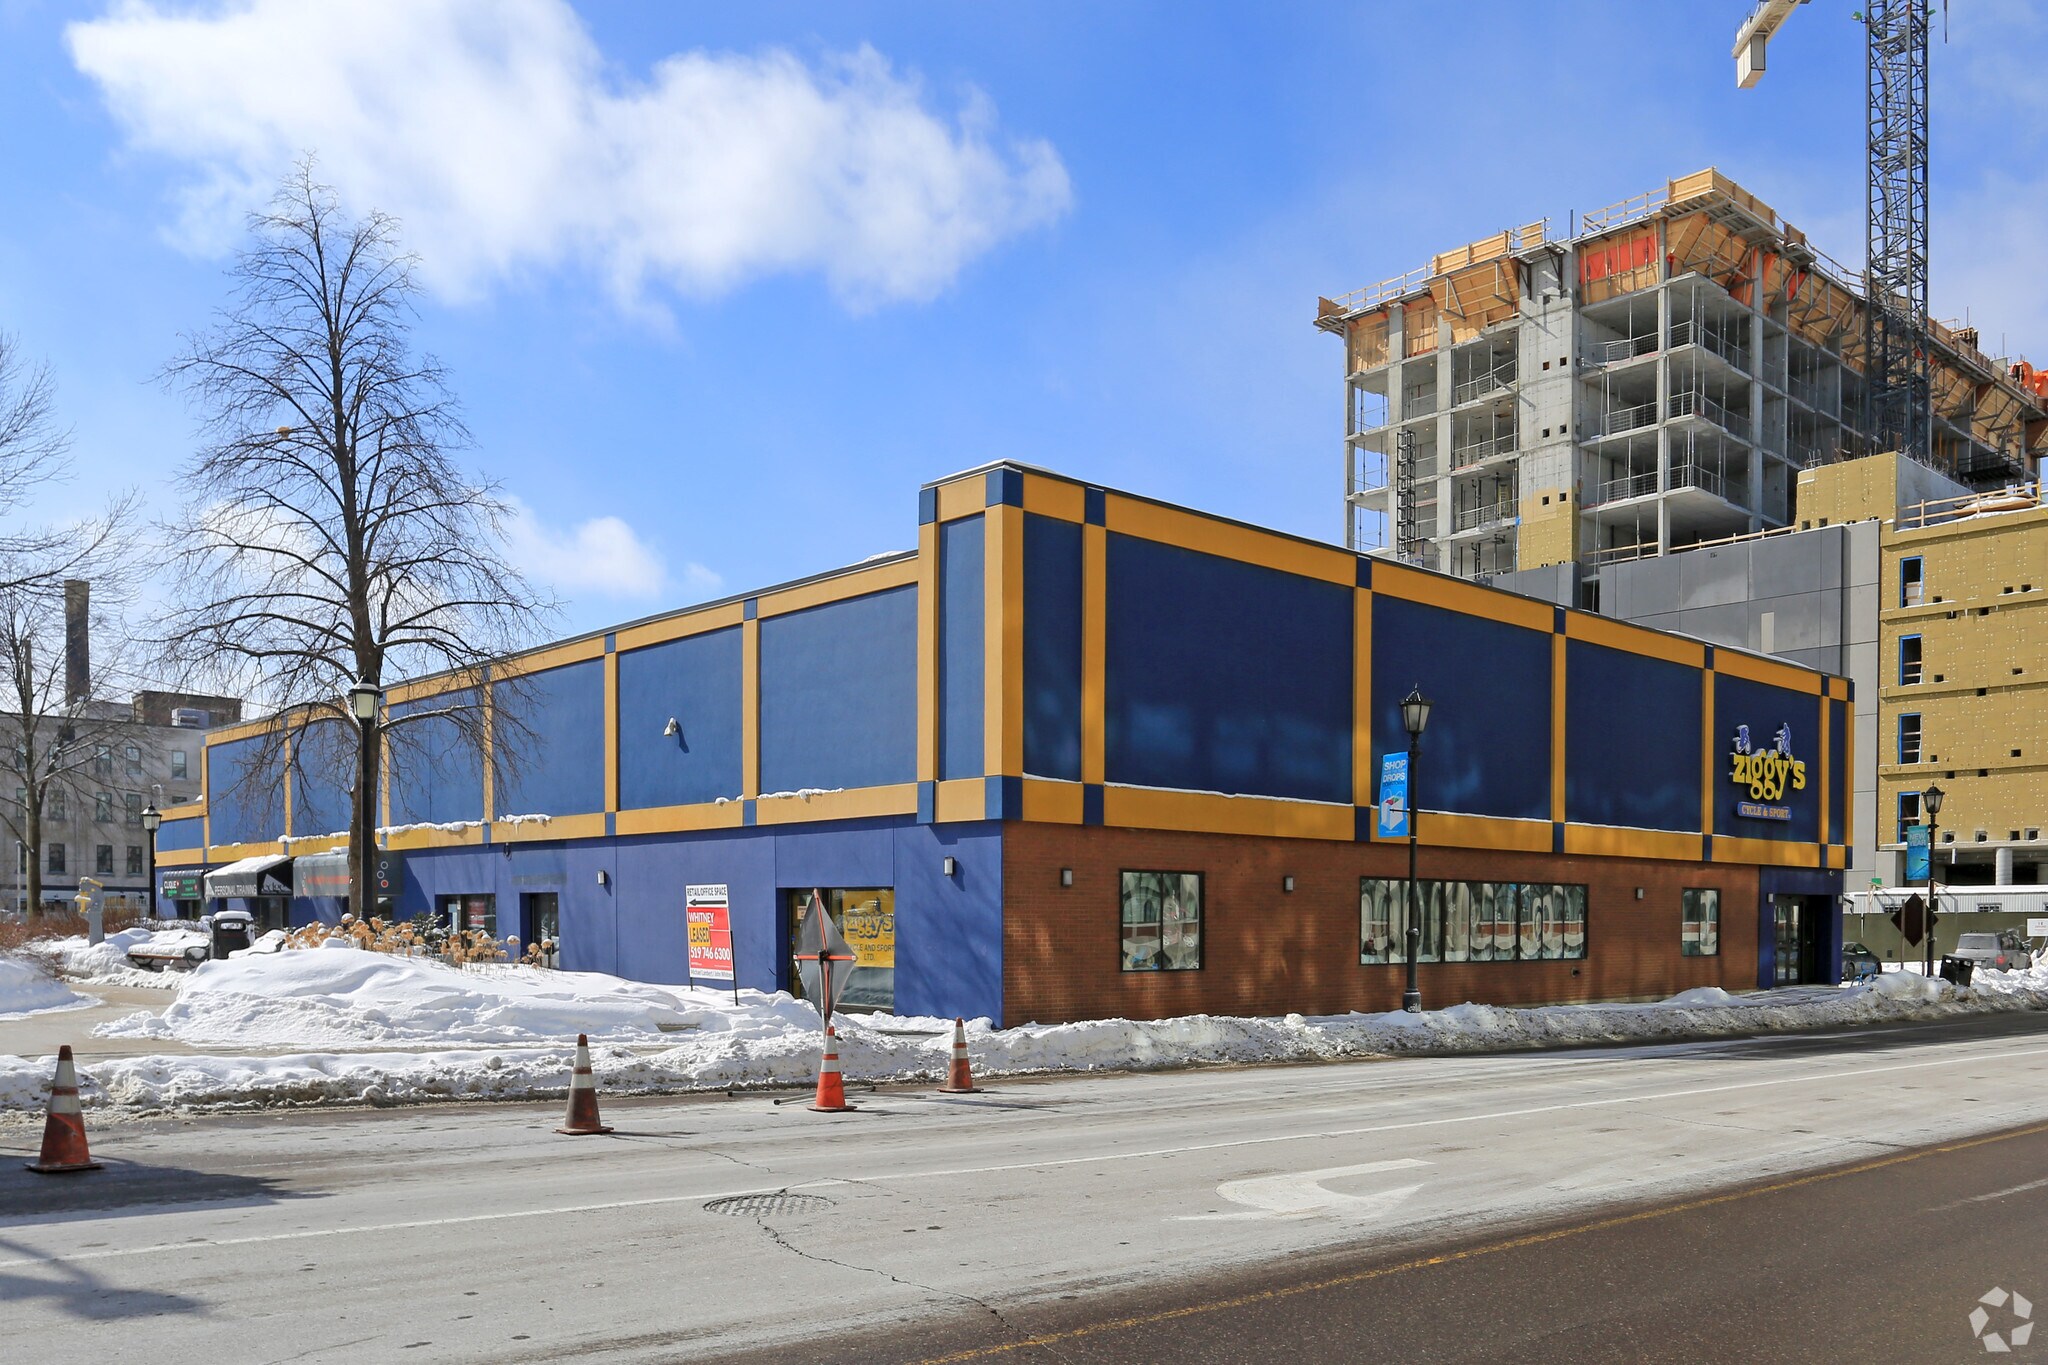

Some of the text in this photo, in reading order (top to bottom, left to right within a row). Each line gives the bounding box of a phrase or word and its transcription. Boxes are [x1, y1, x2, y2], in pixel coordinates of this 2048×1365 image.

[1384, 760, 1406, 771] SHOP
[1383, 772, 1406, 783] DROPS
[1741, 804, 1761, 816] CYCLE
[1763, 807, 1768, 816] &
[1910, 832, 1925, 840] NEW
[214, 884, 257, 896] PERSONAL TRAINING
[687, 886, 727, 897] RETAIL OFFICE SPACE
[688, 912, 715, 923] WHITNEY
[689, 927, 710, 943] LEASED
[690, 946, 731, 961] 519 746 6300
[864, 944, 876, 952] AND
